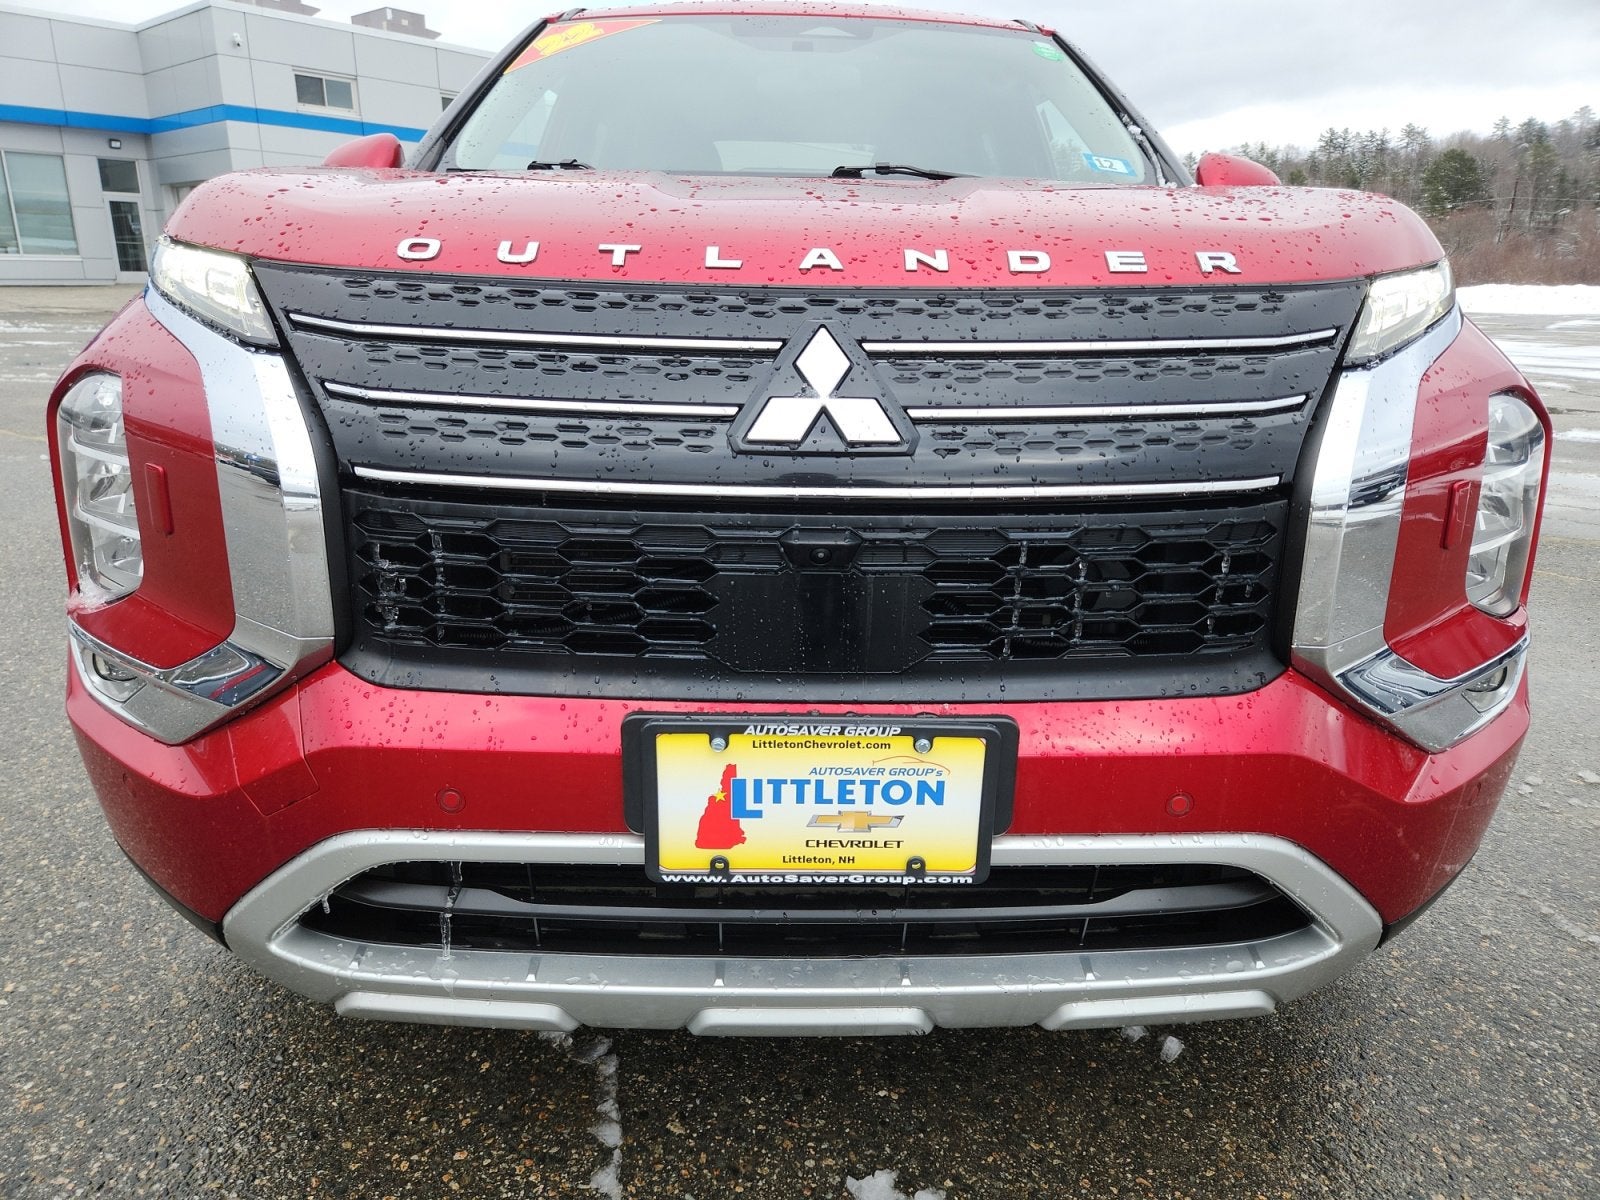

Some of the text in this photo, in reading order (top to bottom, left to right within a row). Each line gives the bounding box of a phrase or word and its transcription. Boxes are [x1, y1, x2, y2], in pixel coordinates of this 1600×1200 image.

[396, 237, 1243, 274] OUTLANDER
[743, 724, 902, 738] AUTOSAVER GROUP
[752, 739, 891, 750] LittletonChevrolet.com
[808, 767, 943, 777] AUTOSAVER GROUP's
[731, 778, 946, 819] LITTLETON
[805, 839, 904, 849] CHEVROLET
[782, 855, 855, 865] Littleton, NH
